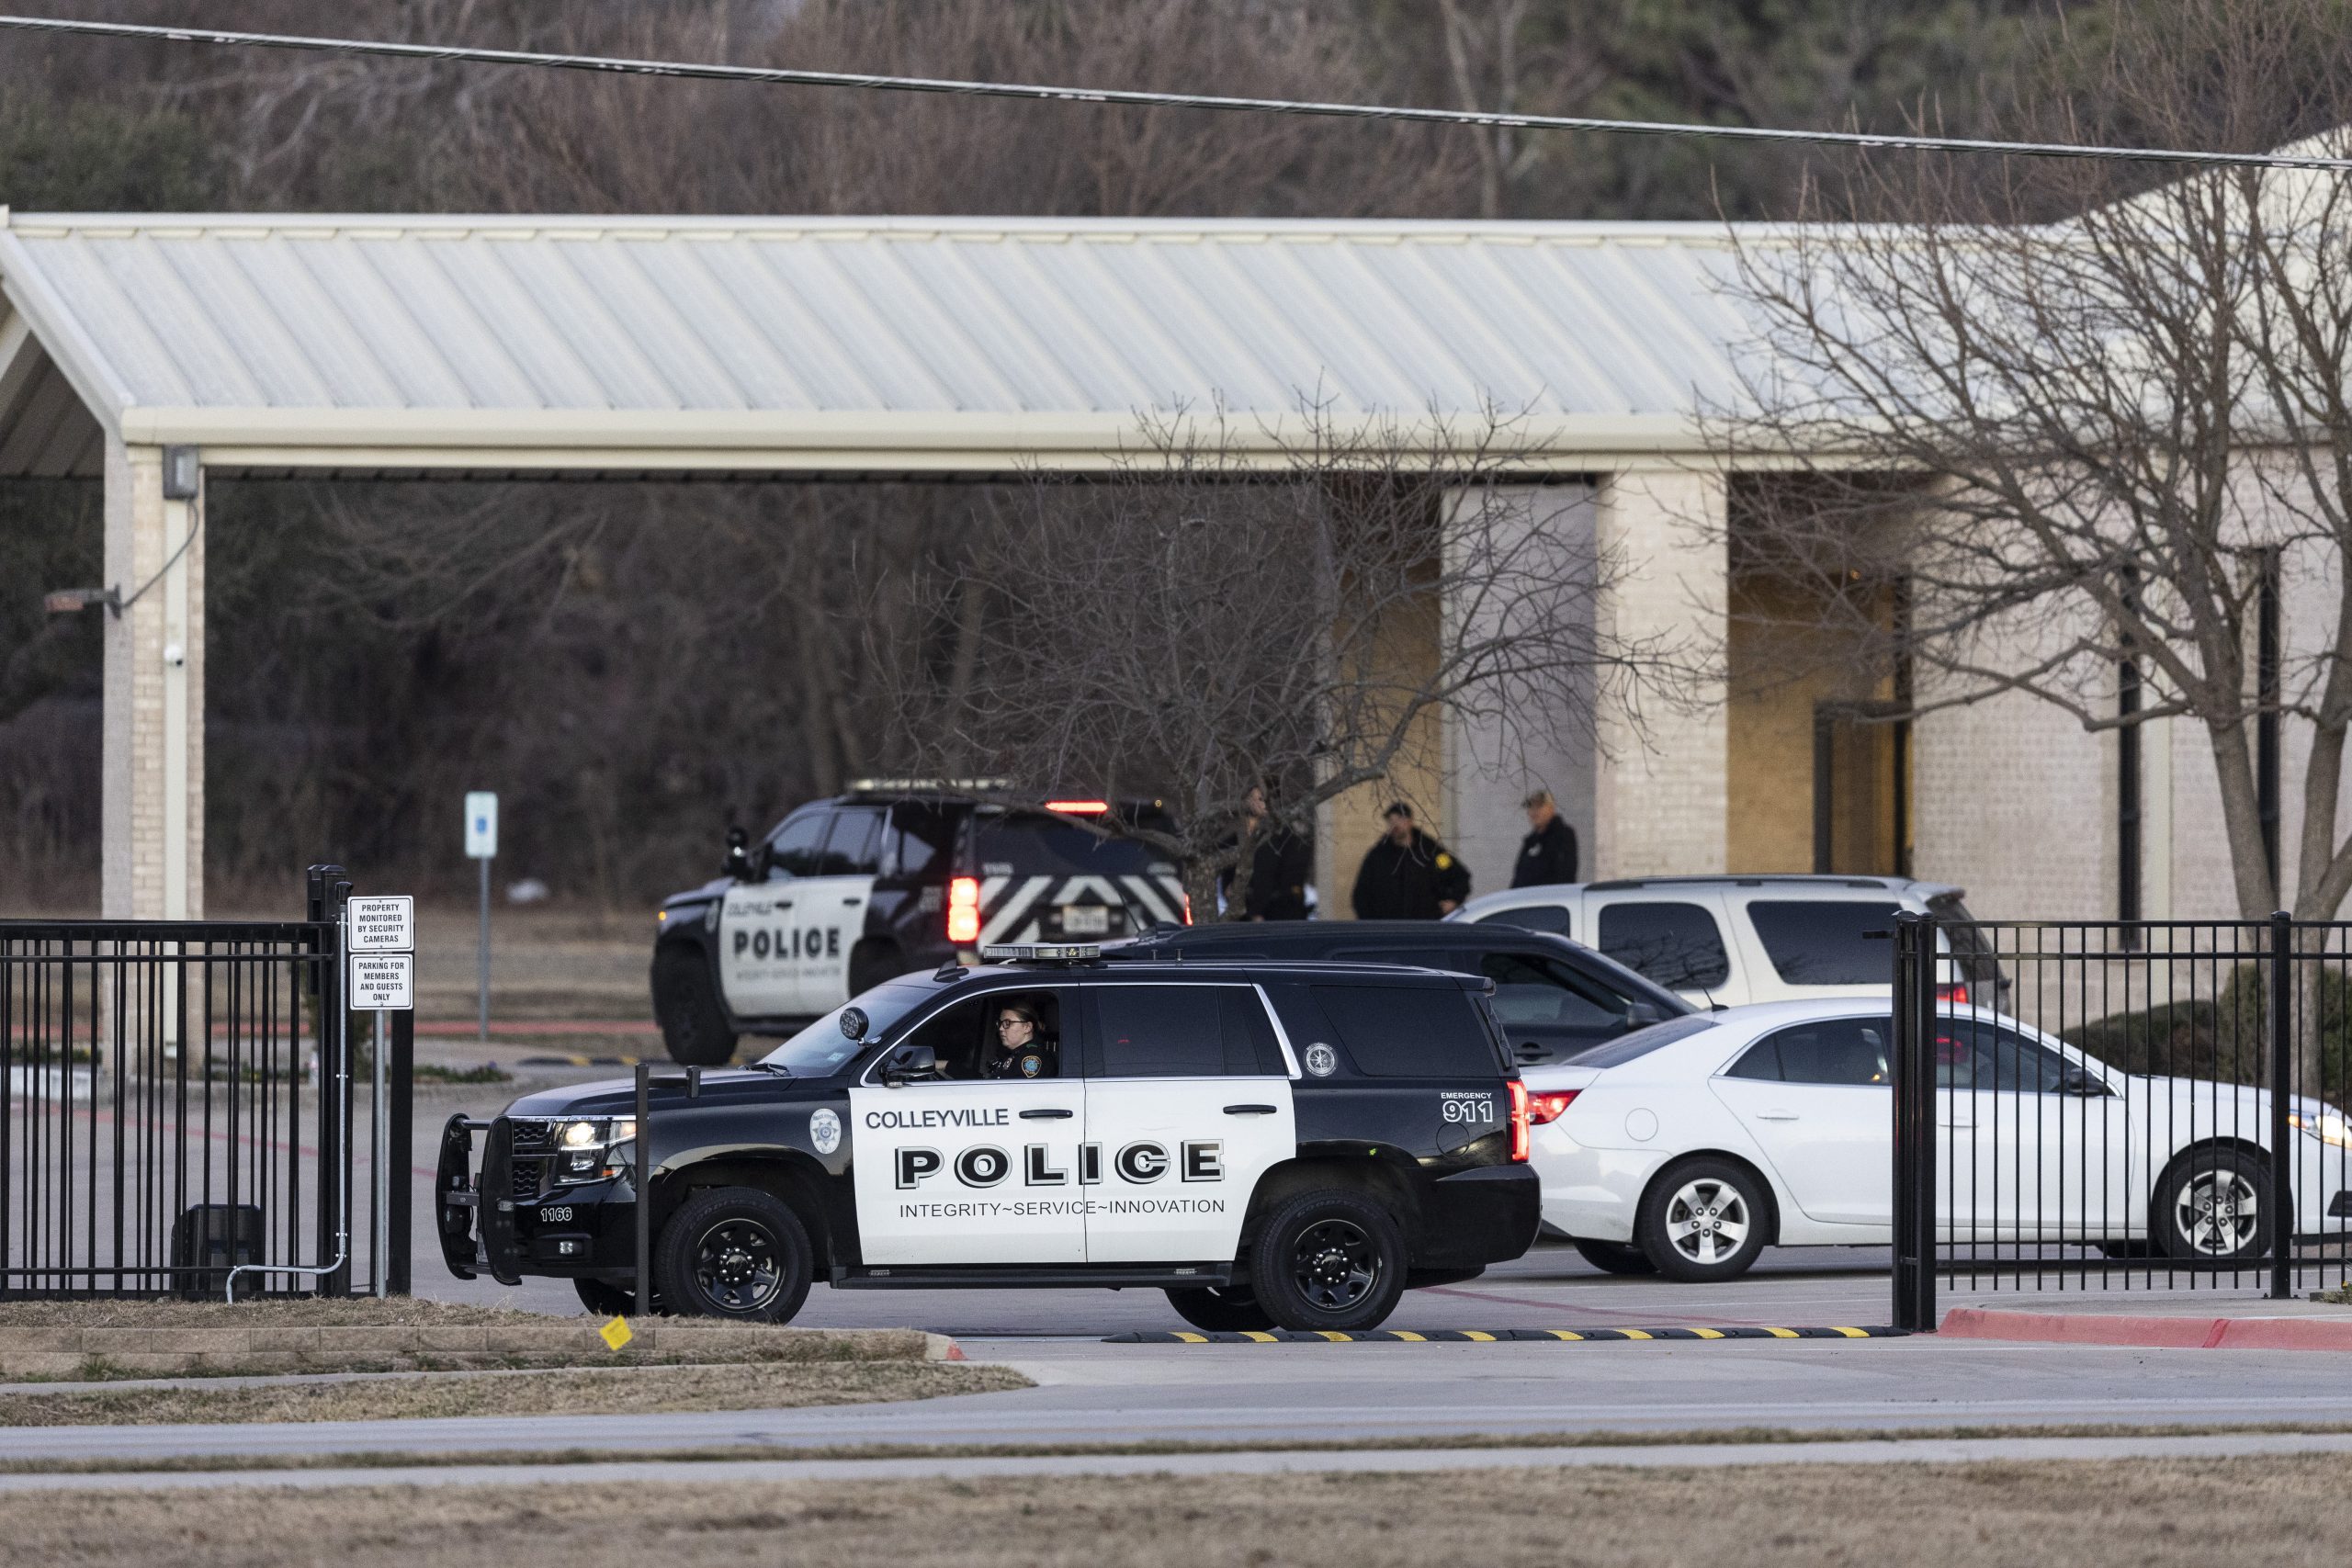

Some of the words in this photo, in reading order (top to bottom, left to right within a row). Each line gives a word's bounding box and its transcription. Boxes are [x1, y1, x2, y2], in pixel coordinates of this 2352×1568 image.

[359, 914, 402, 922] MONITORED
[368, 924, 404, 932] SECURITY
[733, 928, 840, 960] POLICE
[358, 962, 389, 970] PARKING
[373, 993, 390, 1001] ONLY
[865, 1108, 1010, 1130] COLLEYVILLE
[1442, 1100, 1494, 1122] 911
[895, 1138, 1226, 1190] POLICE
[540, 1206, 572, 1222] 1166
